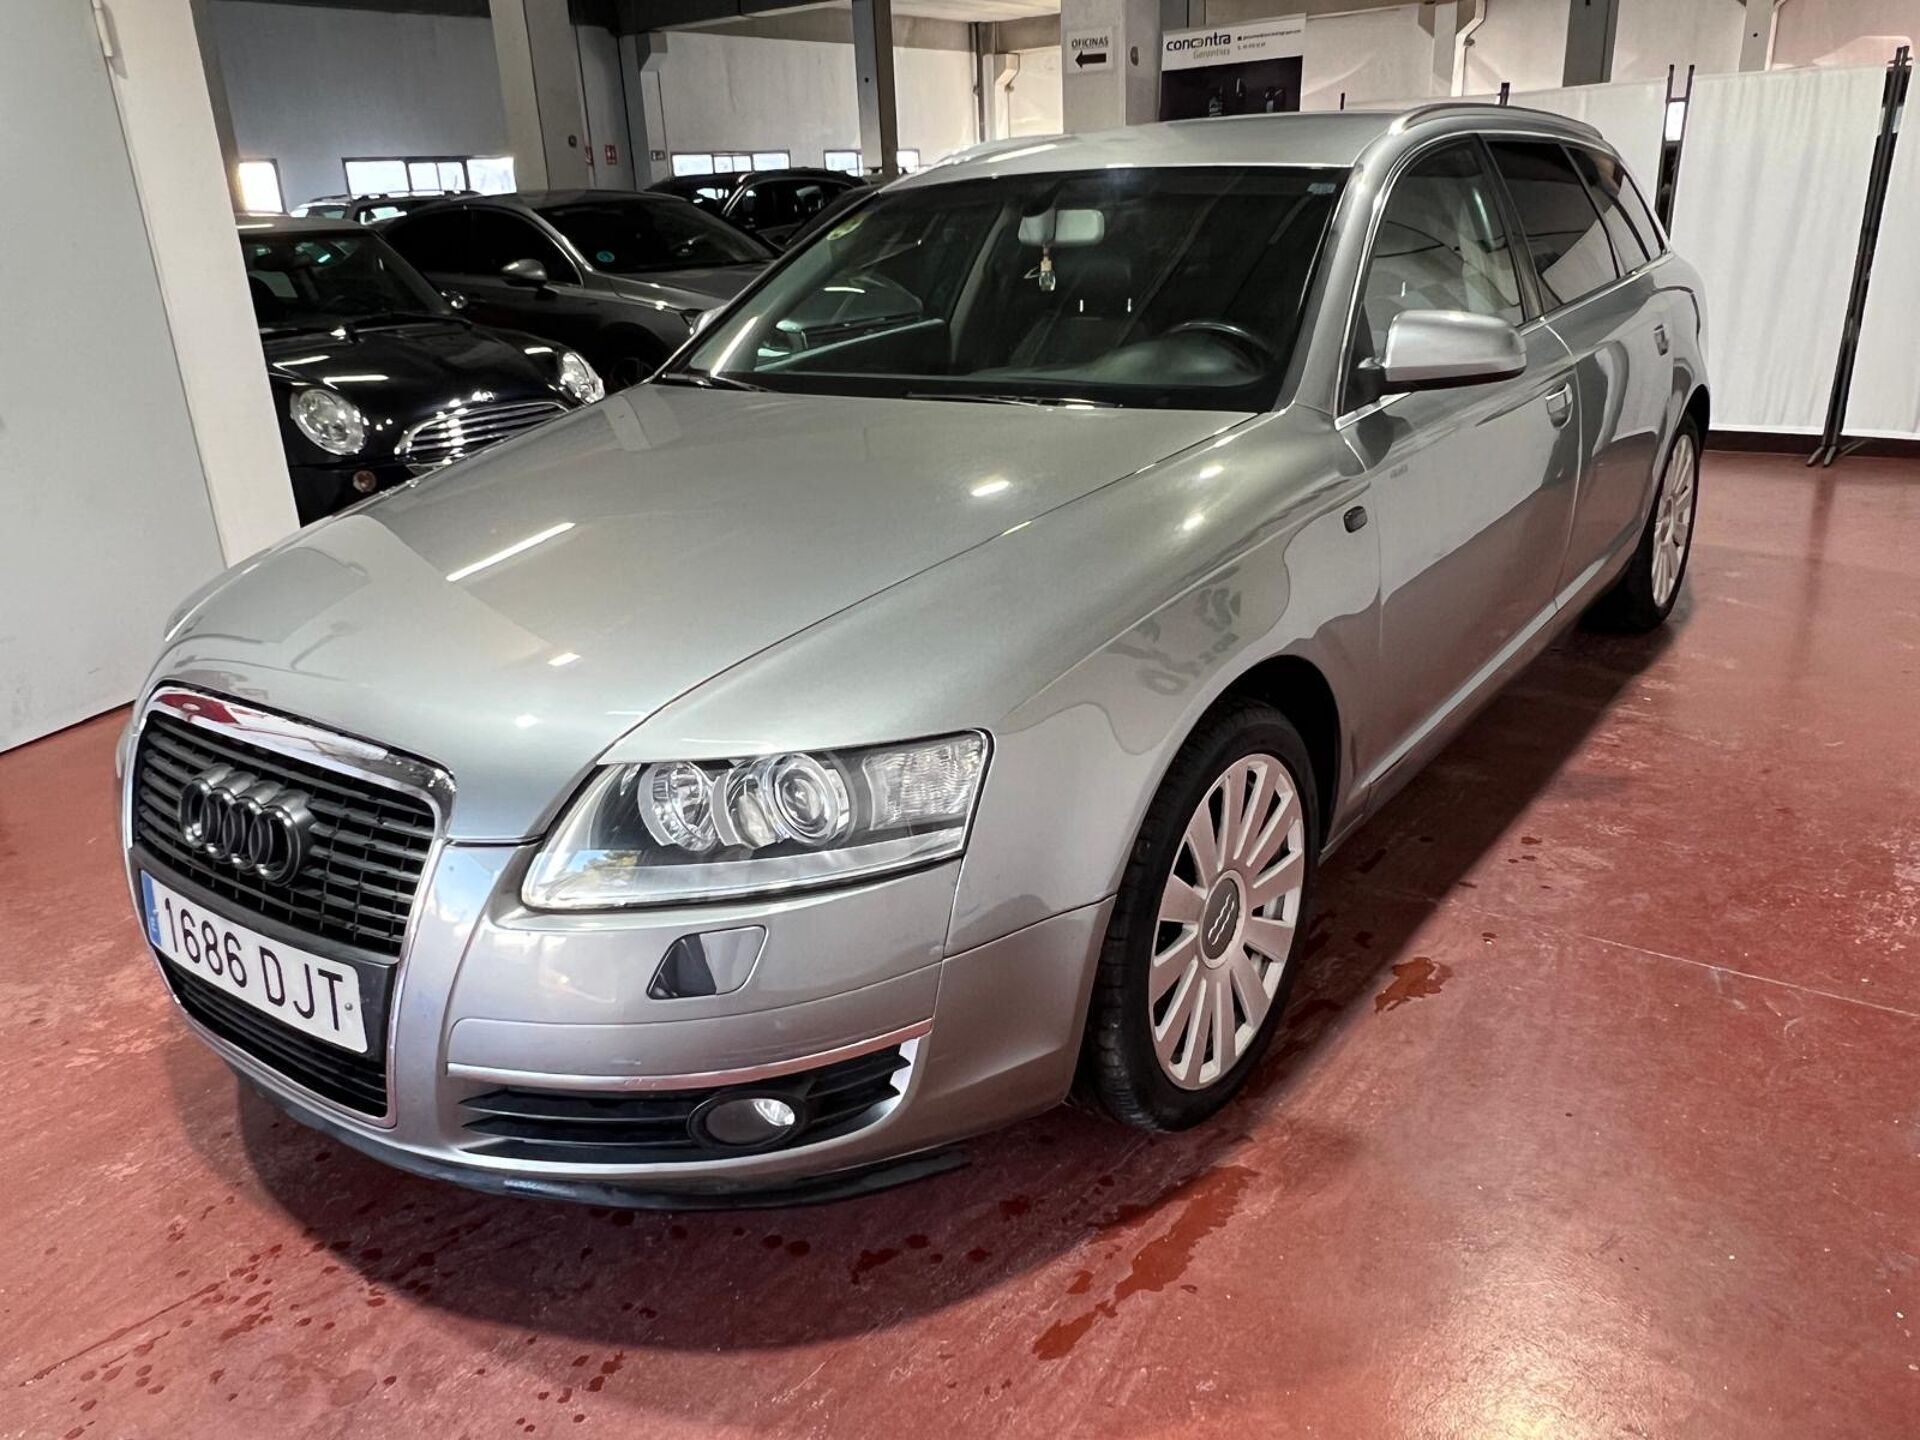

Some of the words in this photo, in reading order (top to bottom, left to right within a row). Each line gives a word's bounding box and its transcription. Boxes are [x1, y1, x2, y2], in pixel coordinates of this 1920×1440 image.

[1071, 36, 1109, 49] OFICINAS
[164, 897, 247, 988] 1686
[259, 945, 343, 1031] DJT
